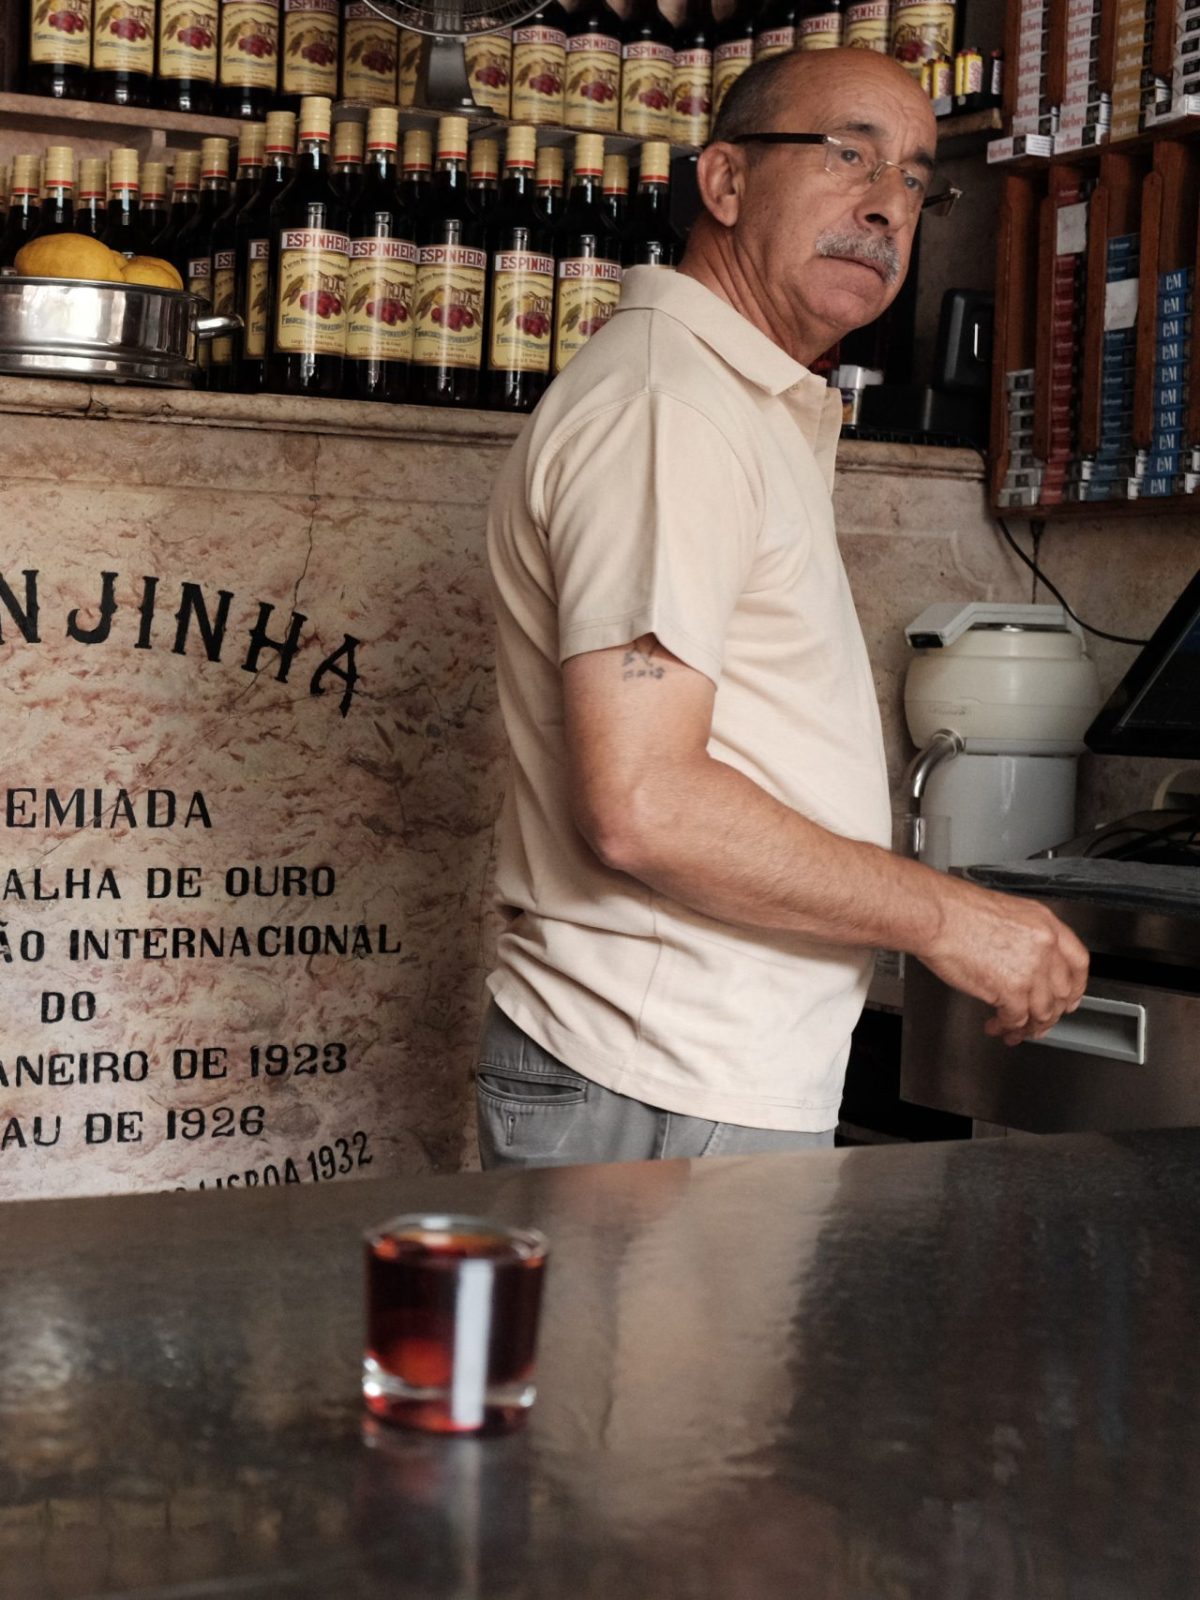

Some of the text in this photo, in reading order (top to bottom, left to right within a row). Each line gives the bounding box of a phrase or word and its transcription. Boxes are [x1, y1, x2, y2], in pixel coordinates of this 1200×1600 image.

[287, 233, 349, 254] ESPINHEIR
[146, 866, 202, 899] DE
[225, 863, 336, 899] OURO
[69, 924, 402, 966] INTERNACIONAL
[40, 990, 96, 1024] DO
[173, 1047, 228, 1080] DE
[249, 1042, 348, 1078] 1923
[84, 1111, 143, 1144] DE
[166, 1105, 265, 1141] 1926
[307, 1131, 373, 1183] 1932
